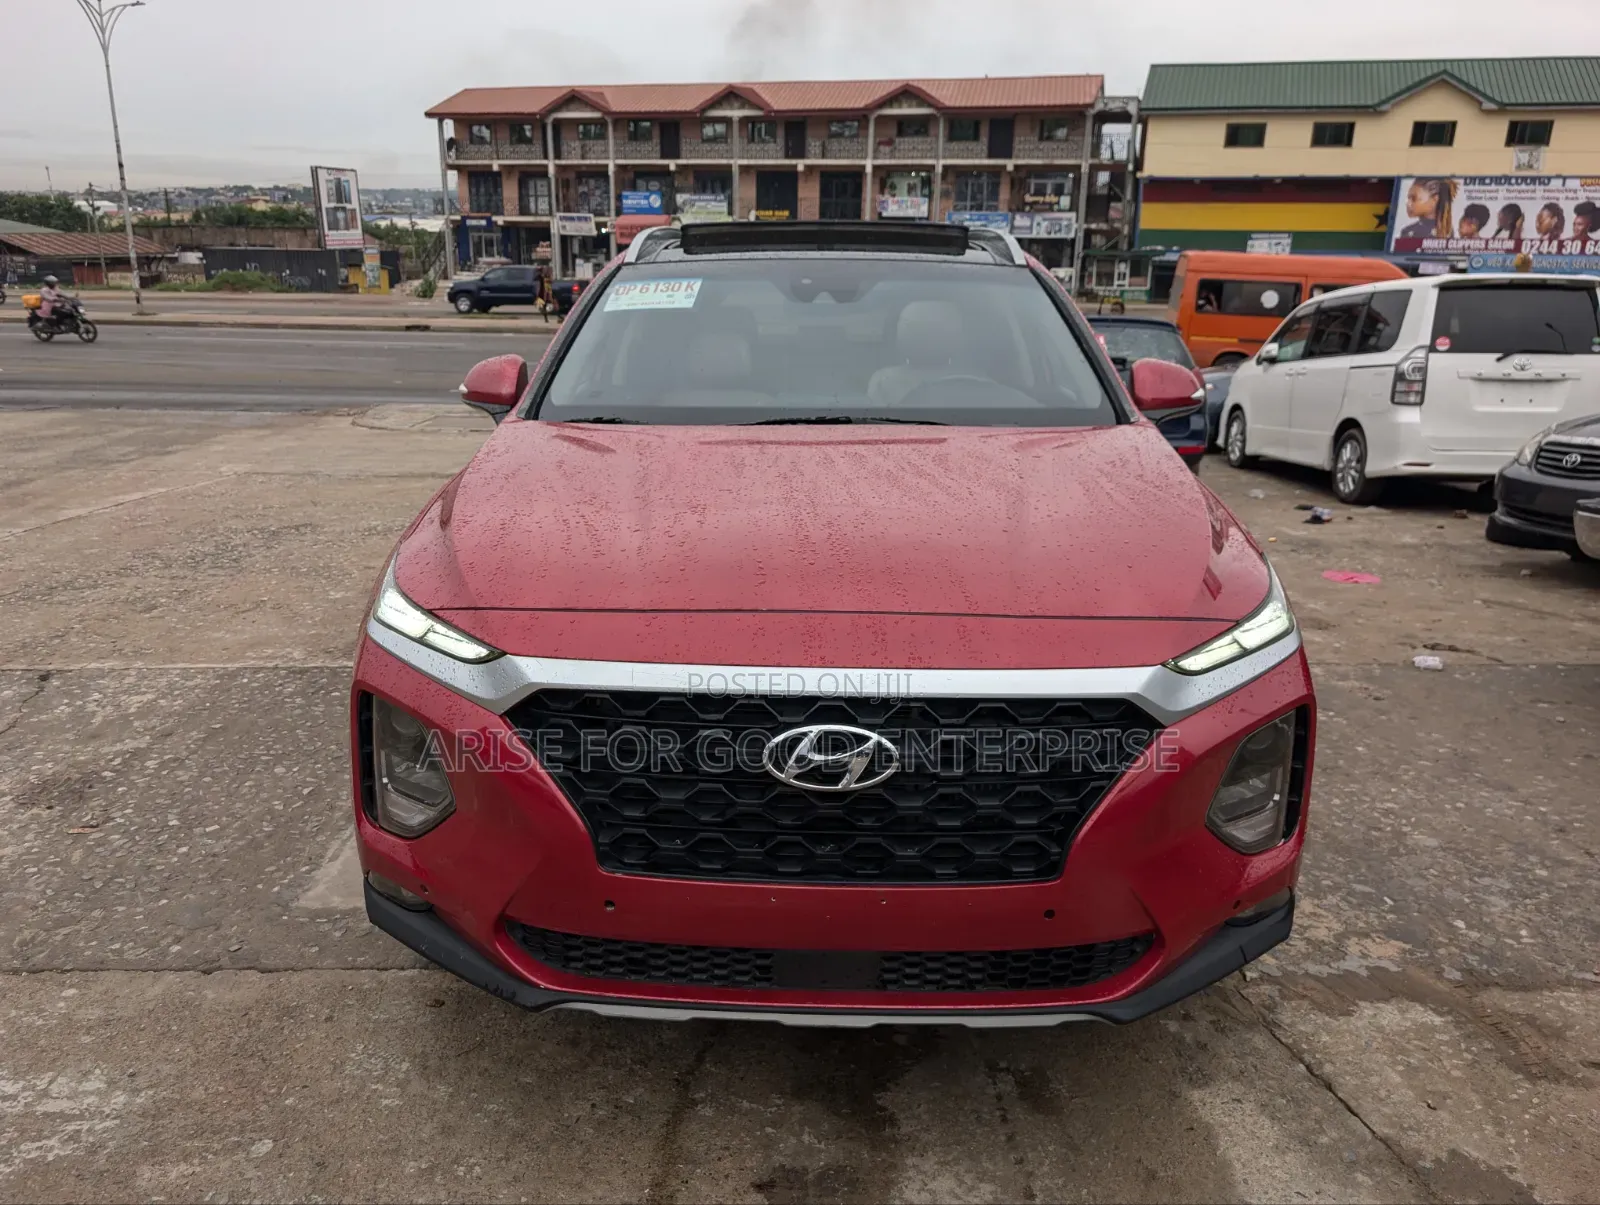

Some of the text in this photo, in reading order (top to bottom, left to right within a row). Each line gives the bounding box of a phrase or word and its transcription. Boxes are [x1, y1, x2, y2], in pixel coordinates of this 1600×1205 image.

[1448, 239, 1486, 249] CLIPPERS
[1487, 239, 1515, 250] SALON
[1521, 239, 1558, 254] 0244
[1562, 240, 1581, 255] 30
